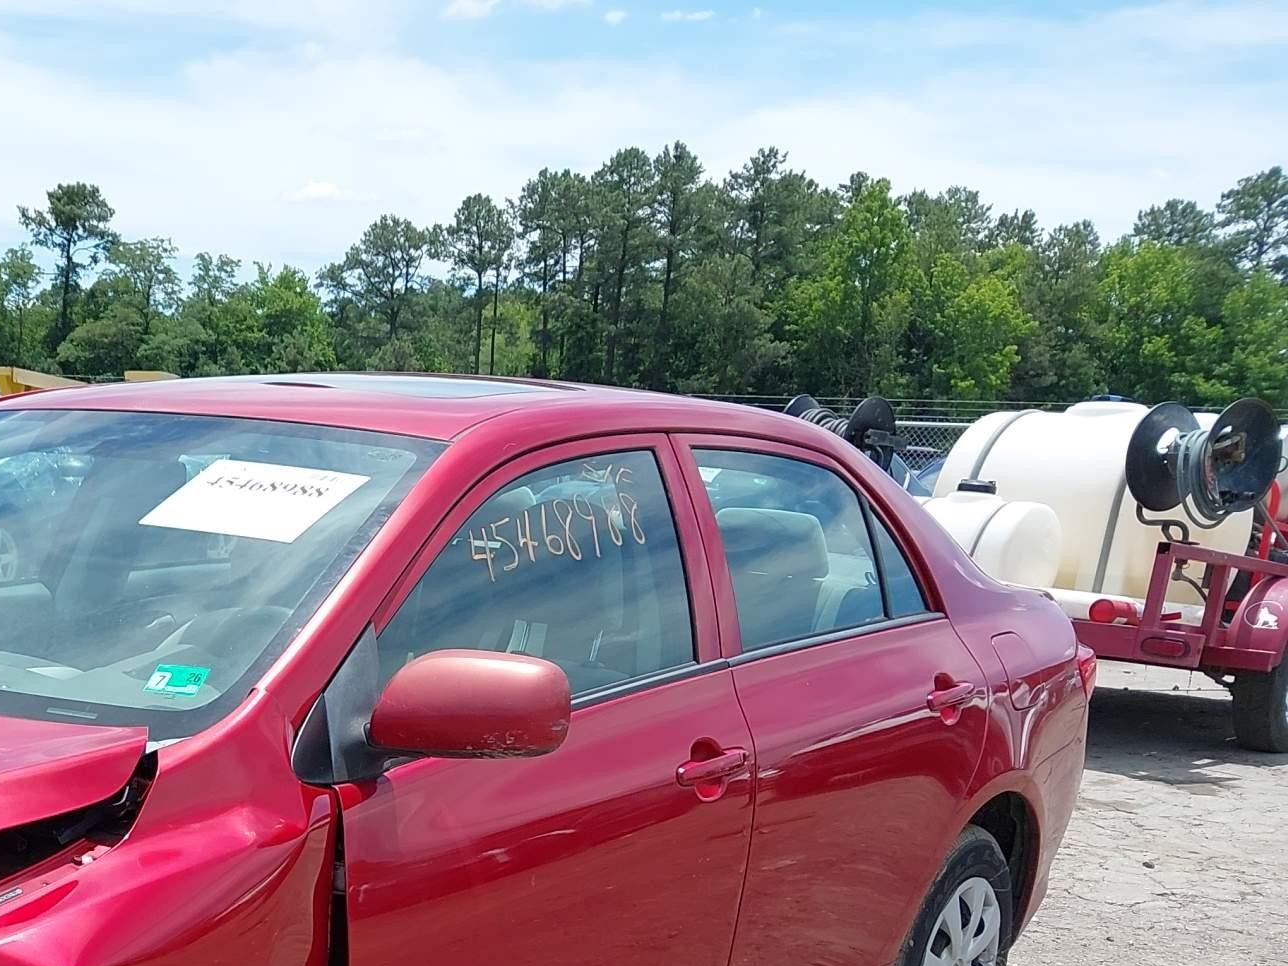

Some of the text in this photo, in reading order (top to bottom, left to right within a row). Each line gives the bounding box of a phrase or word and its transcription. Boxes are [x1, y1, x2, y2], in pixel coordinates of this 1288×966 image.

[469, 493, 645, 583] 45468988
[155, 675, 167, 688] 7
[186, 672, 202, 683] 26
